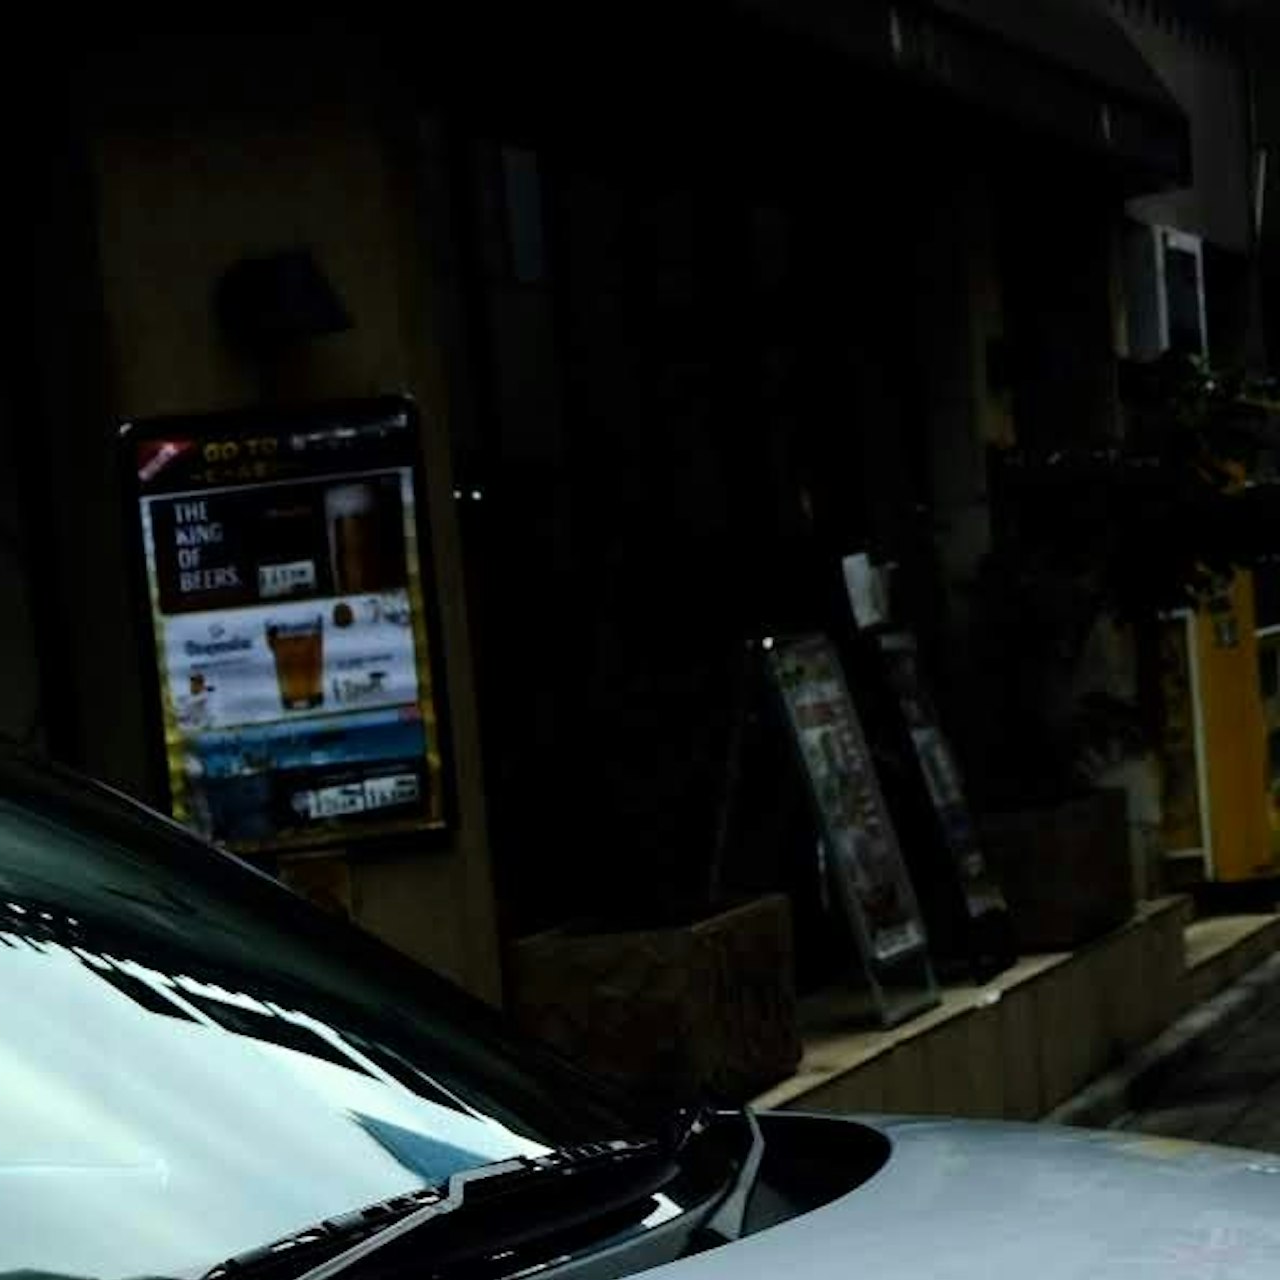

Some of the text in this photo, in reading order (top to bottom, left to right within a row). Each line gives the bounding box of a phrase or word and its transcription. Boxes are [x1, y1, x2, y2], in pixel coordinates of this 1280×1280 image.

[173, 501, 209, 523] THE
[174, 521, 225, 546] KING
[178, 547, 202, 571] OF
